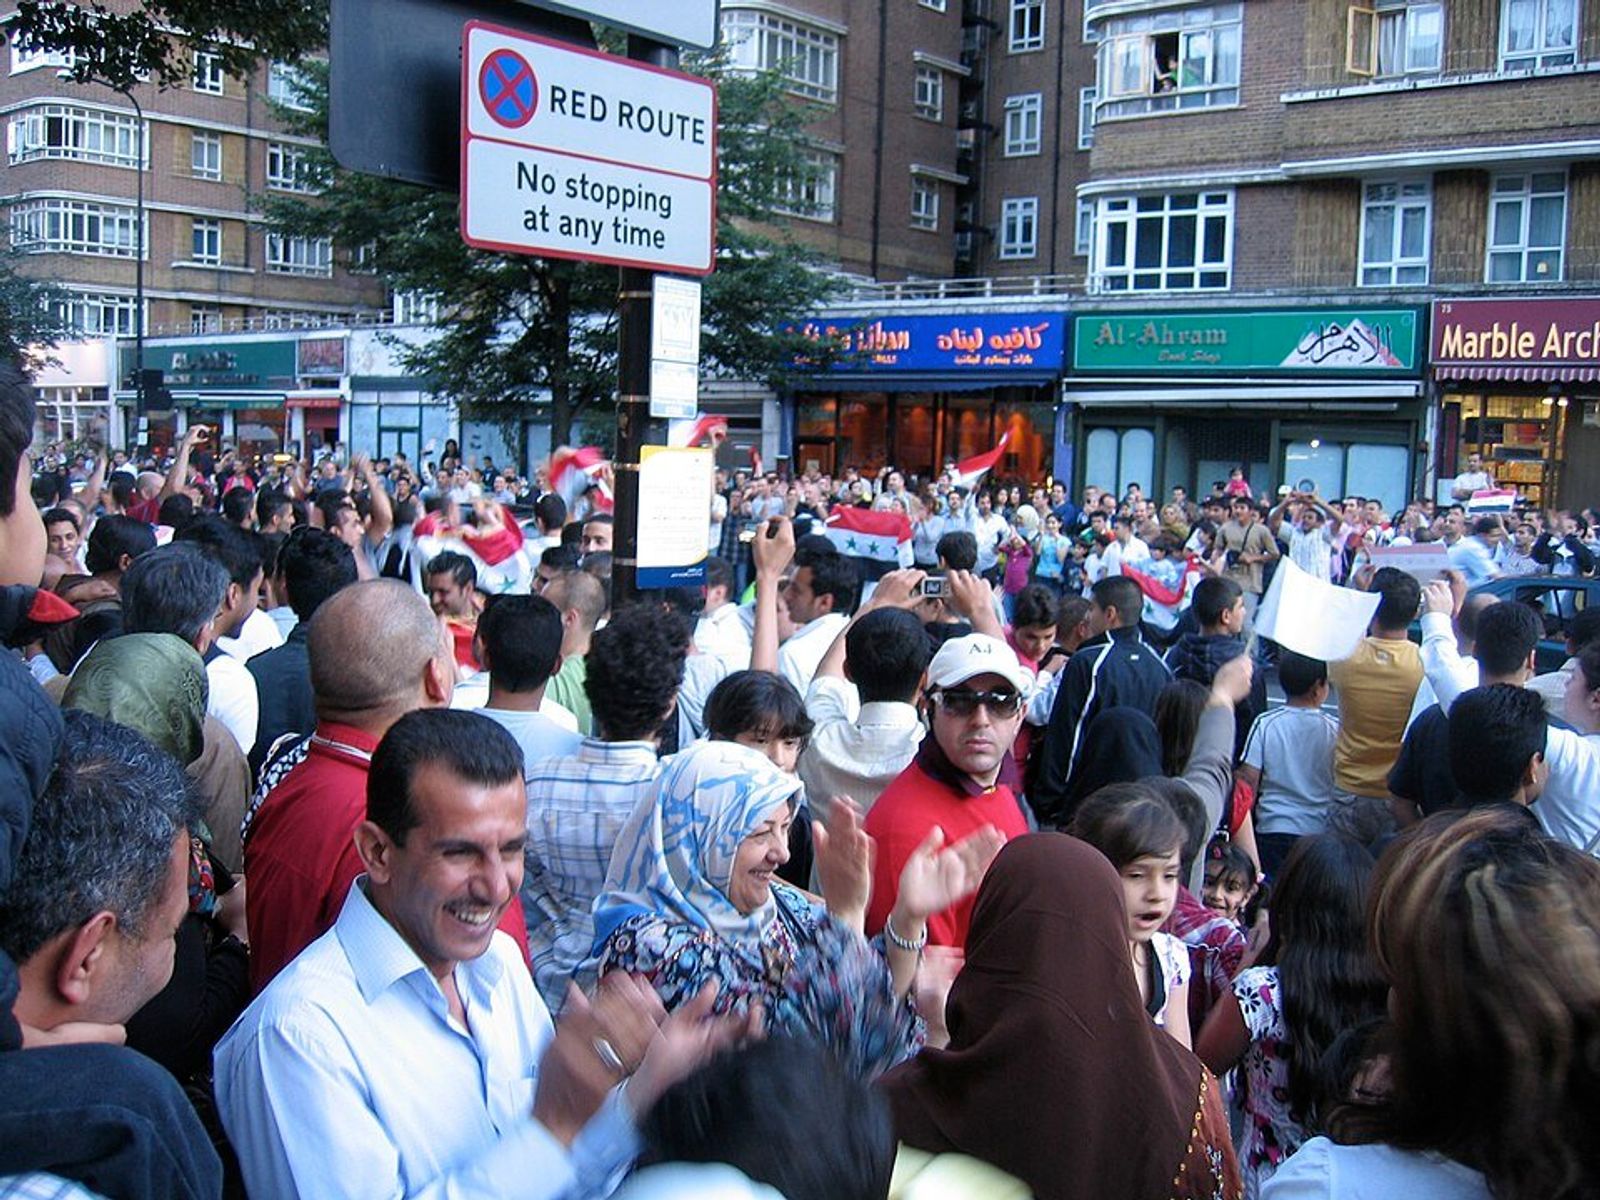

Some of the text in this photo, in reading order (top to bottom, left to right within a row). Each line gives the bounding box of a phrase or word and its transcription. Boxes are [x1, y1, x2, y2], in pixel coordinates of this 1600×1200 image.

[550, 85, 705, 145] RED ROUTE
[517, 161, 672, 219] No stopping
[523, 205, 666, 250] at any time
[1093, 320, 1228, 350] Al-Ahram
[1440, 322, 1535, 359] Marble
